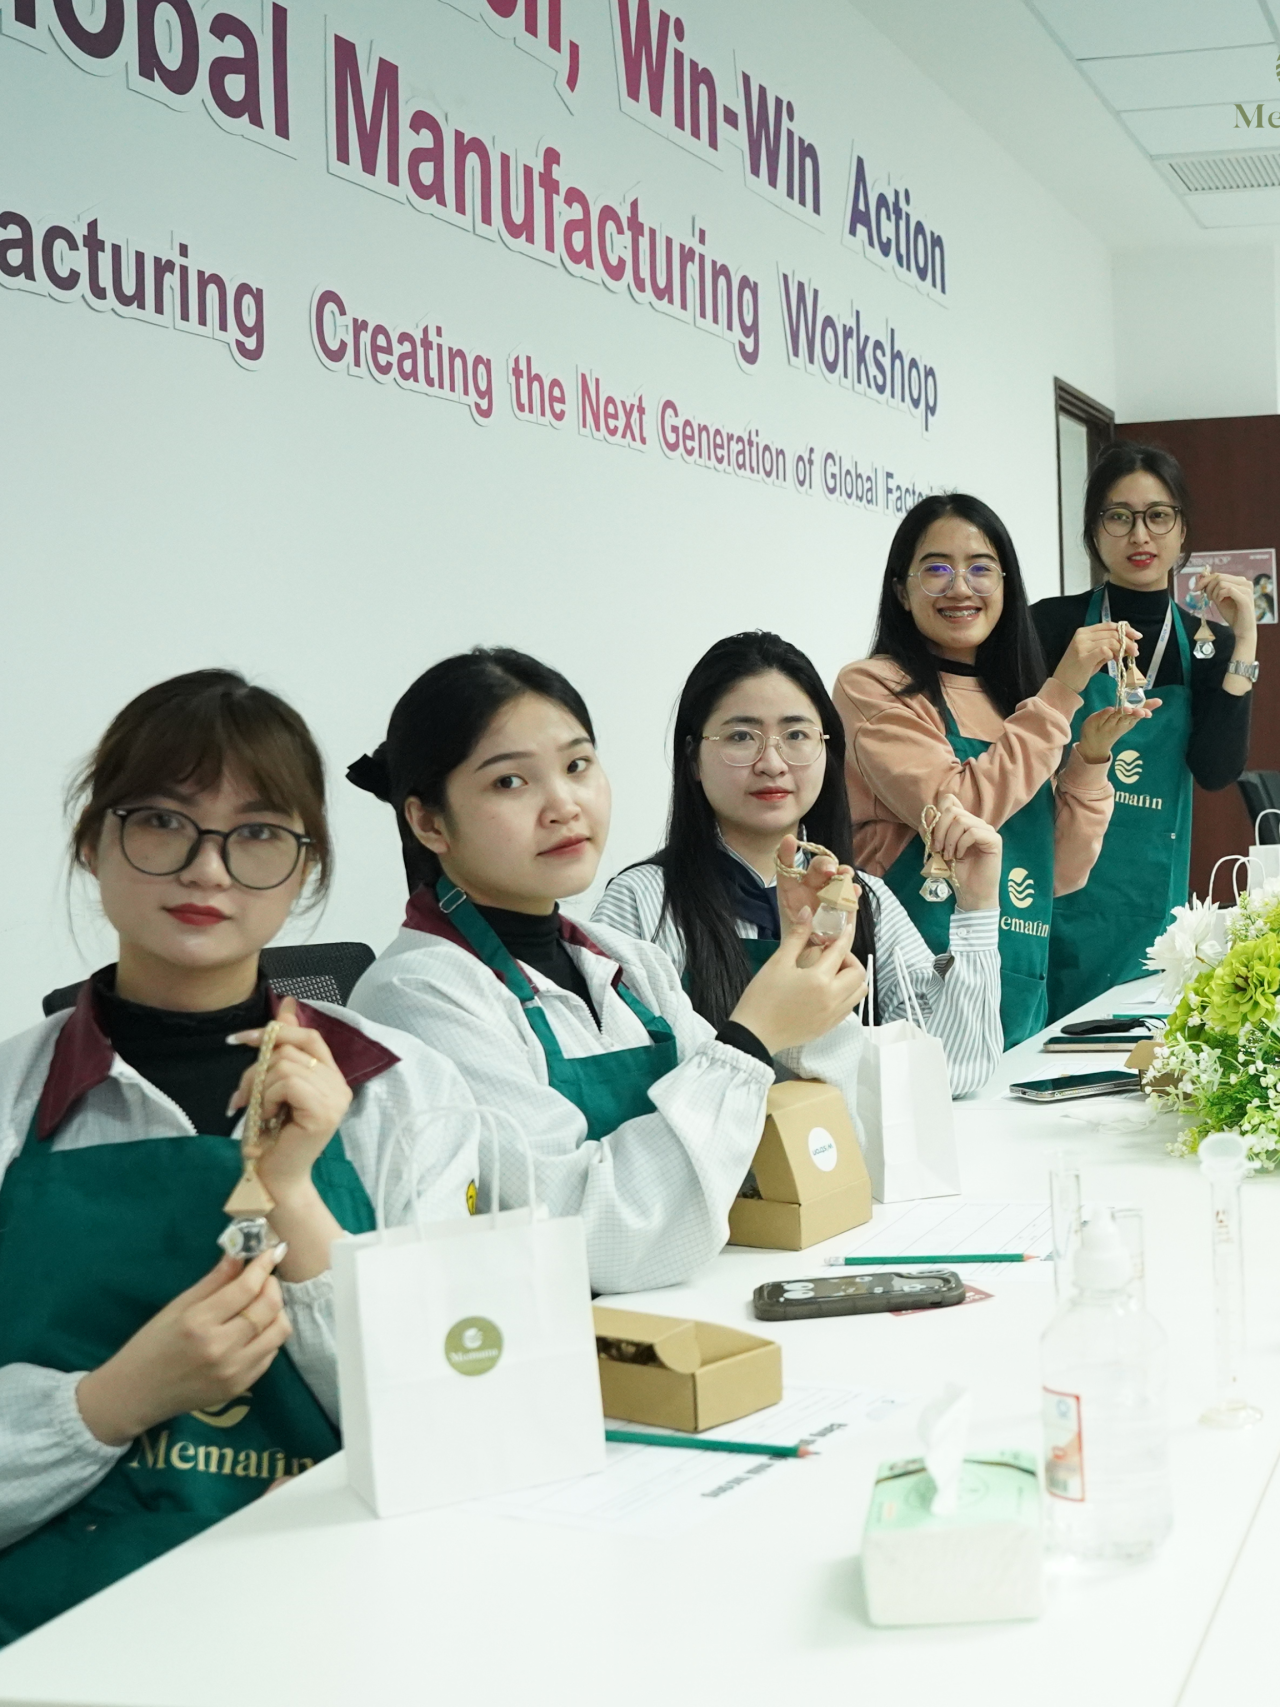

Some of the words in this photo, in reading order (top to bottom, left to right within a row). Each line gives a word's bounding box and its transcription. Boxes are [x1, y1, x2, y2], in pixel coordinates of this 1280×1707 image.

[333, 33, 760, 366] Manufacturing
[783, 273, 938, 432] Workshop
[617, 0, 820, 216] Win-Win
[849, 155, 946, 296] Action
[0, 211, 265, 361] acturing
[315, 290, 494, 419] Creating
[511, 355, 566, 422] the
[580, 372, 647, 446] Next
[660, 399, 786, 483] Generation
[795, 446, 815, 490] of
[823, 451, 878, 507] Global
[1000, 915, 1049, 938] emarin
[1114, 790, 1163, 810] marin
